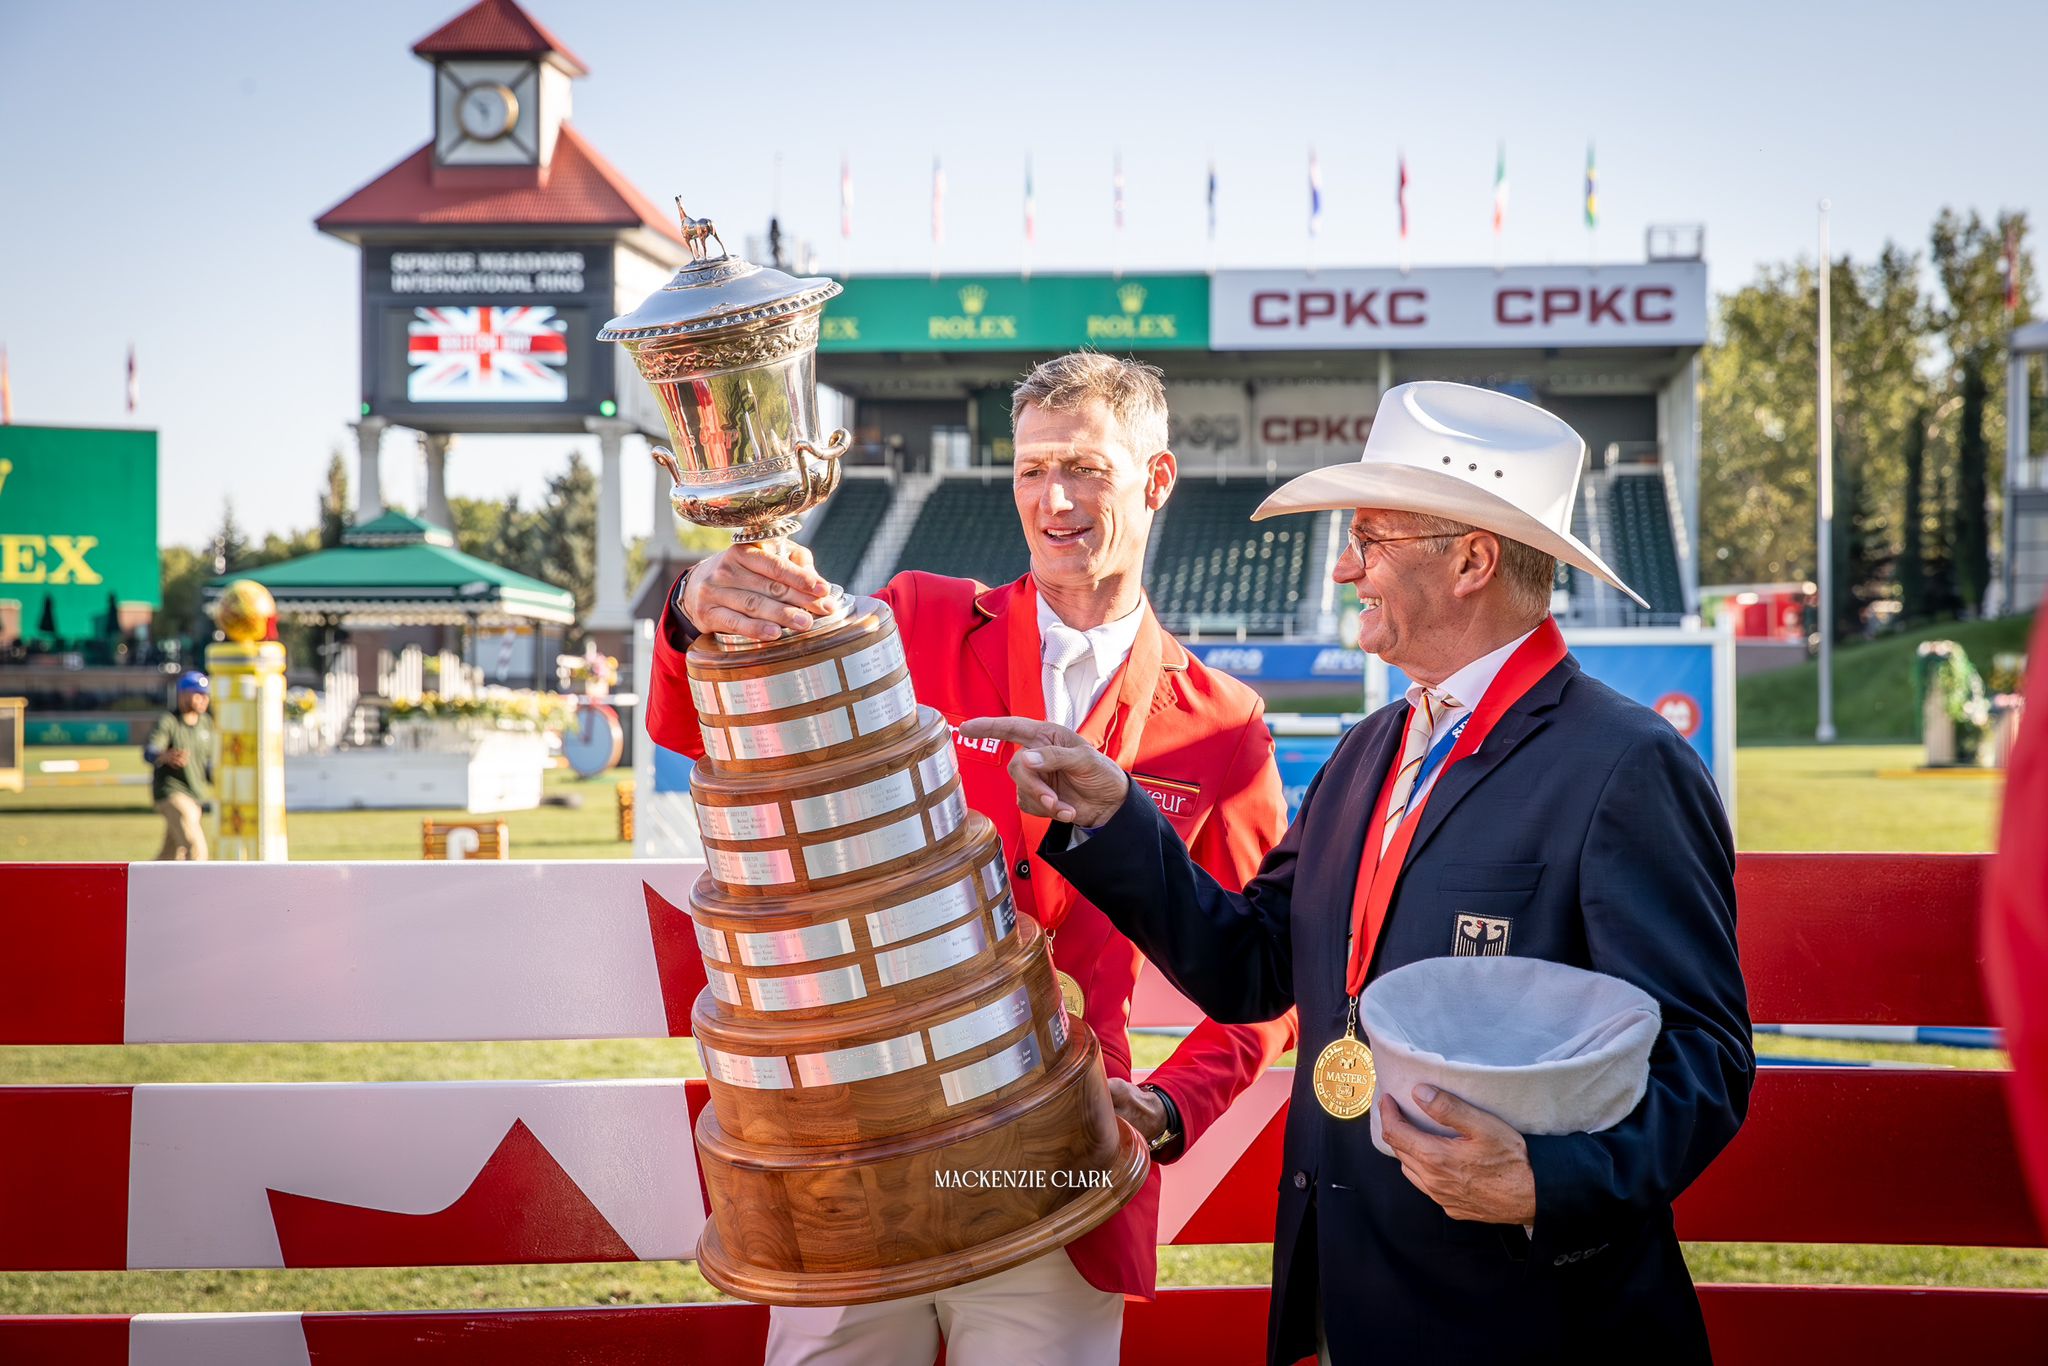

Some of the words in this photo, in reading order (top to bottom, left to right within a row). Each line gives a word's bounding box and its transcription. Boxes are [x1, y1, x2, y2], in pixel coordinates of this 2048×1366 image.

[392, 273, 533, 292] INTERNATIONAL
[1252, 290, 1428, 328] CPKC
[1493, 287, 1675, 325] CPKC
[929, 315, 1017, 339] ROLEX
[1088, 314, 1177, 339] ROLEX
[1326, 1071, 1368, 1085] MASTERS
